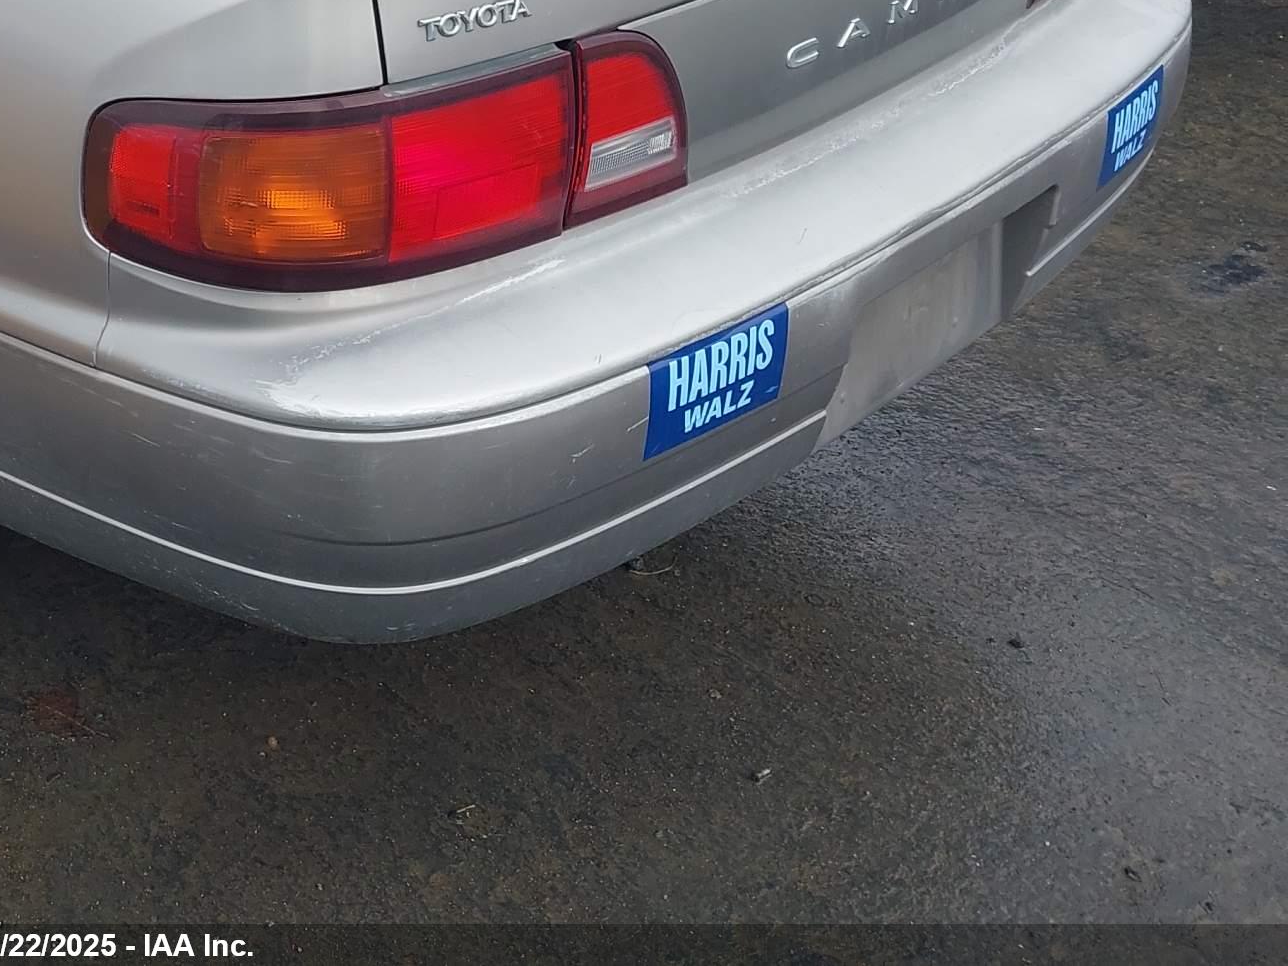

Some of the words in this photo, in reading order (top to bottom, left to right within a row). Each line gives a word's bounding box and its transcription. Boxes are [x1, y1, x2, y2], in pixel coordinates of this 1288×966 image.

[1111, 80, 1159, 154] HARRIS
[1114, 129, 1147, 172] WALZ
[667, 319, 775, 412] HARRIS
[684, 379, 755, 433] WALZ
